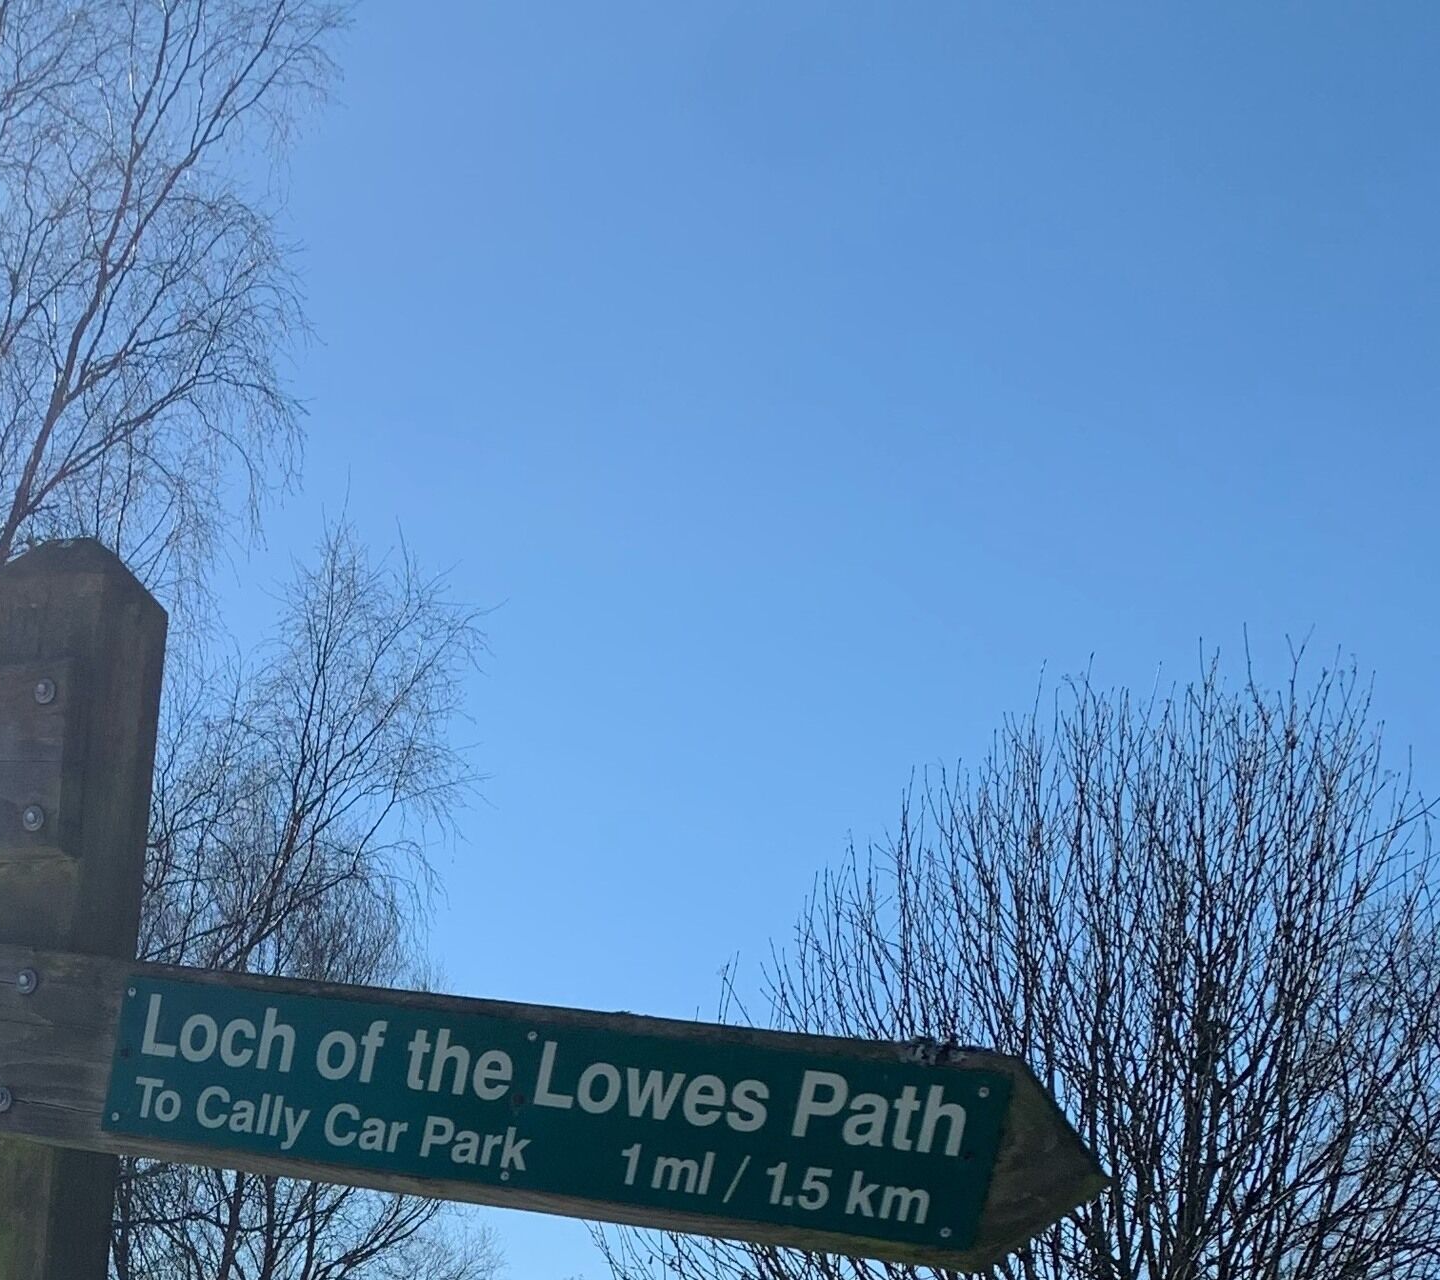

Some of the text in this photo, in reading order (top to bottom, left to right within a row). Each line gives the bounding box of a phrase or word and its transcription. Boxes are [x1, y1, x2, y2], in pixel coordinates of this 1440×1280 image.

[142, 993, 965, 1156] Loch of the Lowes Path
[135, 1077, 530, 1171] To Cally Car Park
[622, 1144, 642, 1185] 1
[652, 1152, 715, 1195] ml
[768, 1162, 833, 1211] 1.5
[846, 1170, 930, 1224] km
